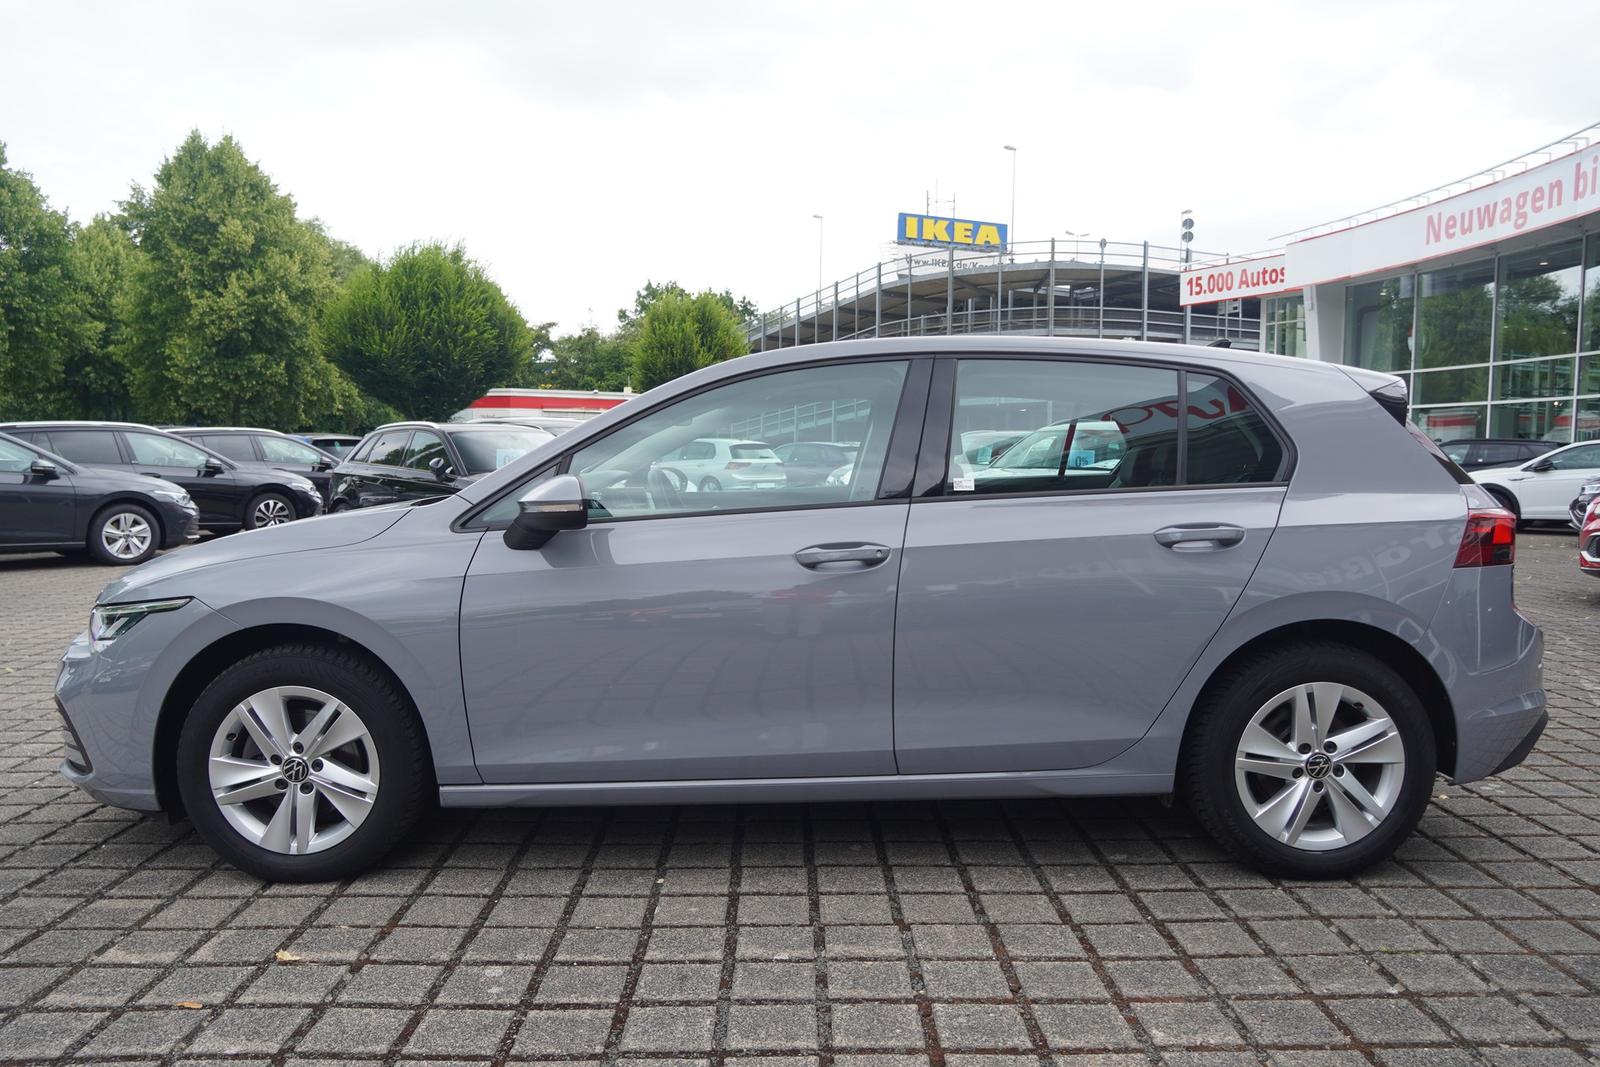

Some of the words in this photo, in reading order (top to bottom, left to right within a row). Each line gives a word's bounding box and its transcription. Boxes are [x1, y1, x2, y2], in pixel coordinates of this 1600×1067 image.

[1425, 179, 1563, 246] Neuwagen
[1573, 154, 1600, 202] bi
[905, 216, 1001, 246] IKEA
[1186, 271, 1234, 297] 15.000
[1238, 266, 1286, 290] Autos
